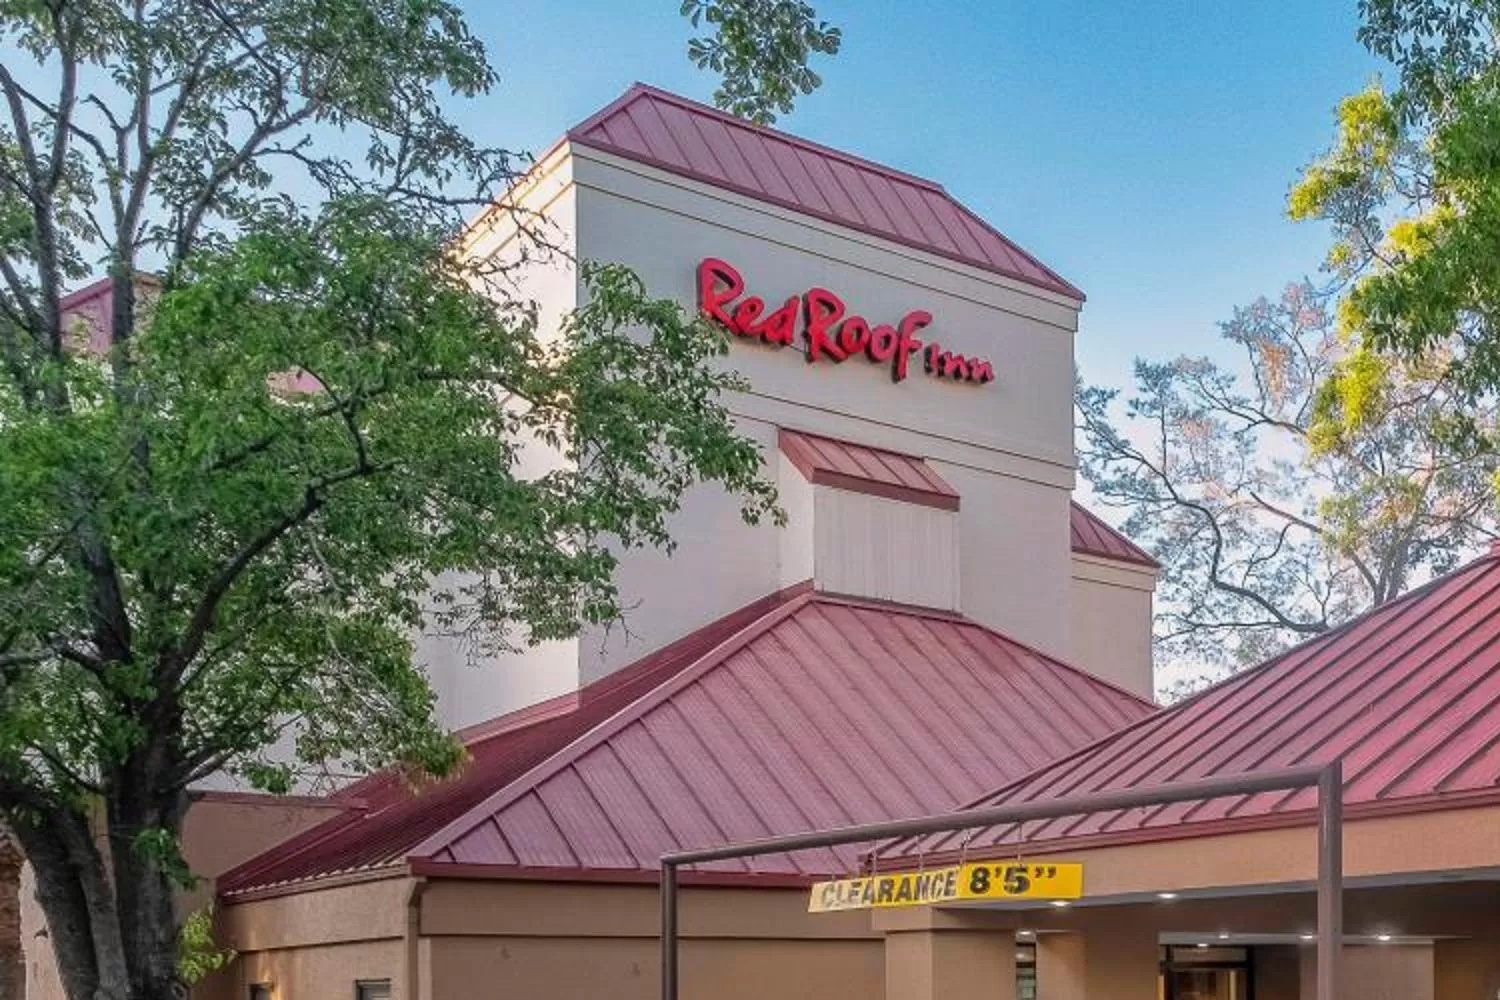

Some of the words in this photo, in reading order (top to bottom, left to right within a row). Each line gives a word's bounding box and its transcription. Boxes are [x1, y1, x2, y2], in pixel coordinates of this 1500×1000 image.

[697, 258, 799, 345] Red
[802, 288, 932, 383] Roof
[821, 869, 959, 907] CLEARANCE
